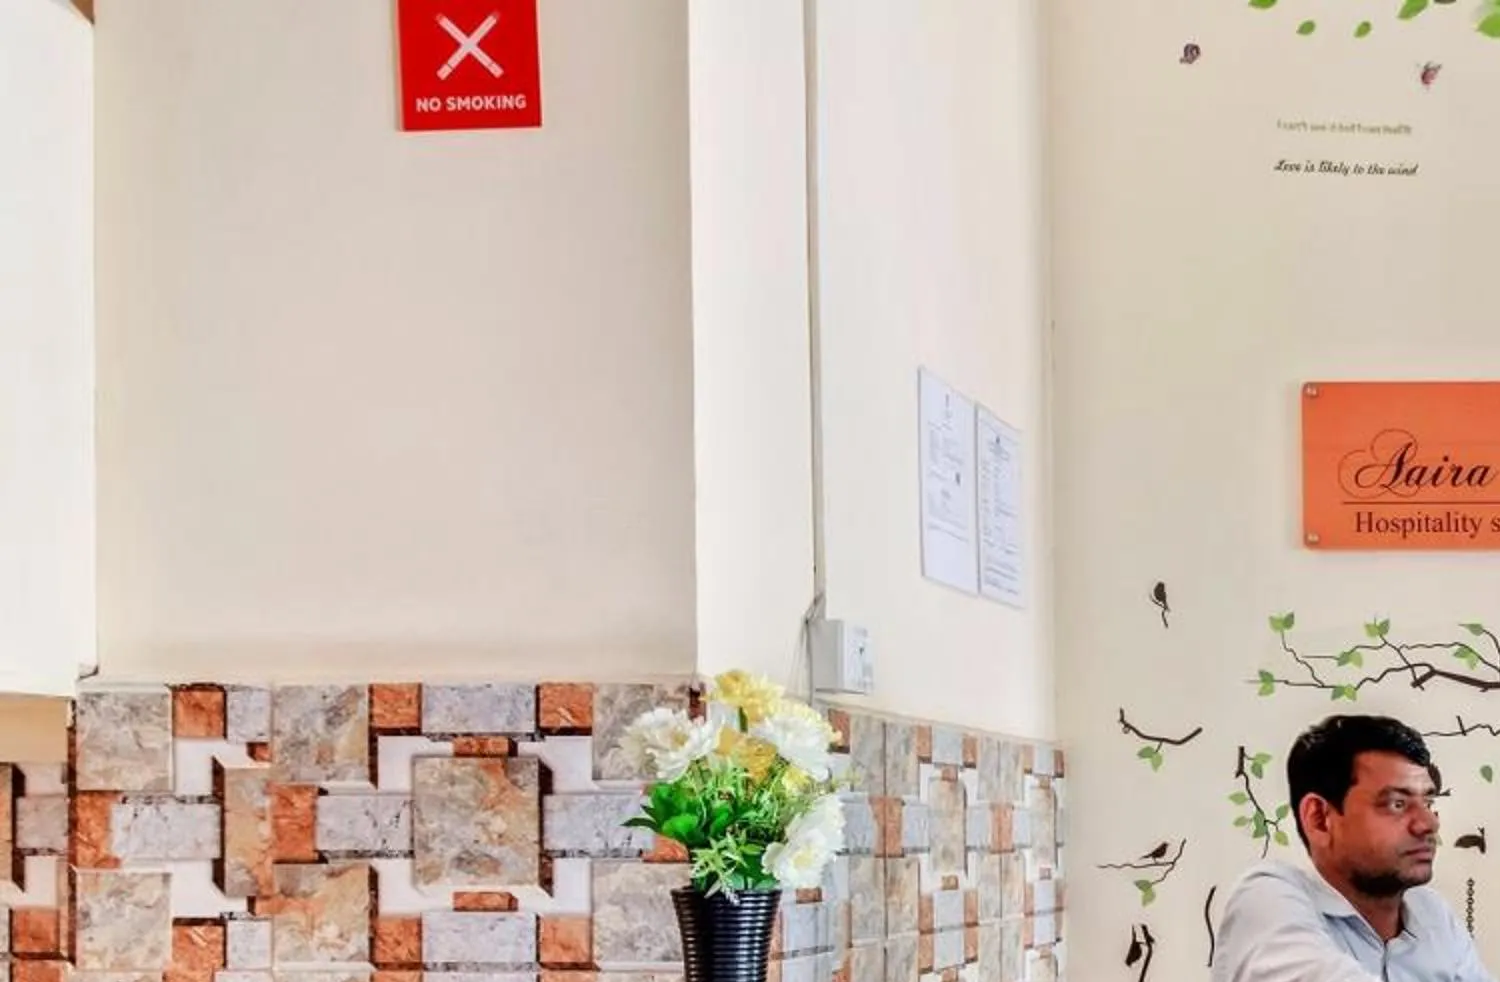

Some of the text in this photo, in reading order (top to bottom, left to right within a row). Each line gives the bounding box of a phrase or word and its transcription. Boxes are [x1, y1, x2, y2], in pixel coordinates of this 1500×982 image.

[415, 93, 528, 112] NO SMOKING
[1274, 159, 1419, 177] Love is likely to the wind
[1338, 428, 1500, 499] Aaira
[1355, 510, 1482, 539] Hospitality
